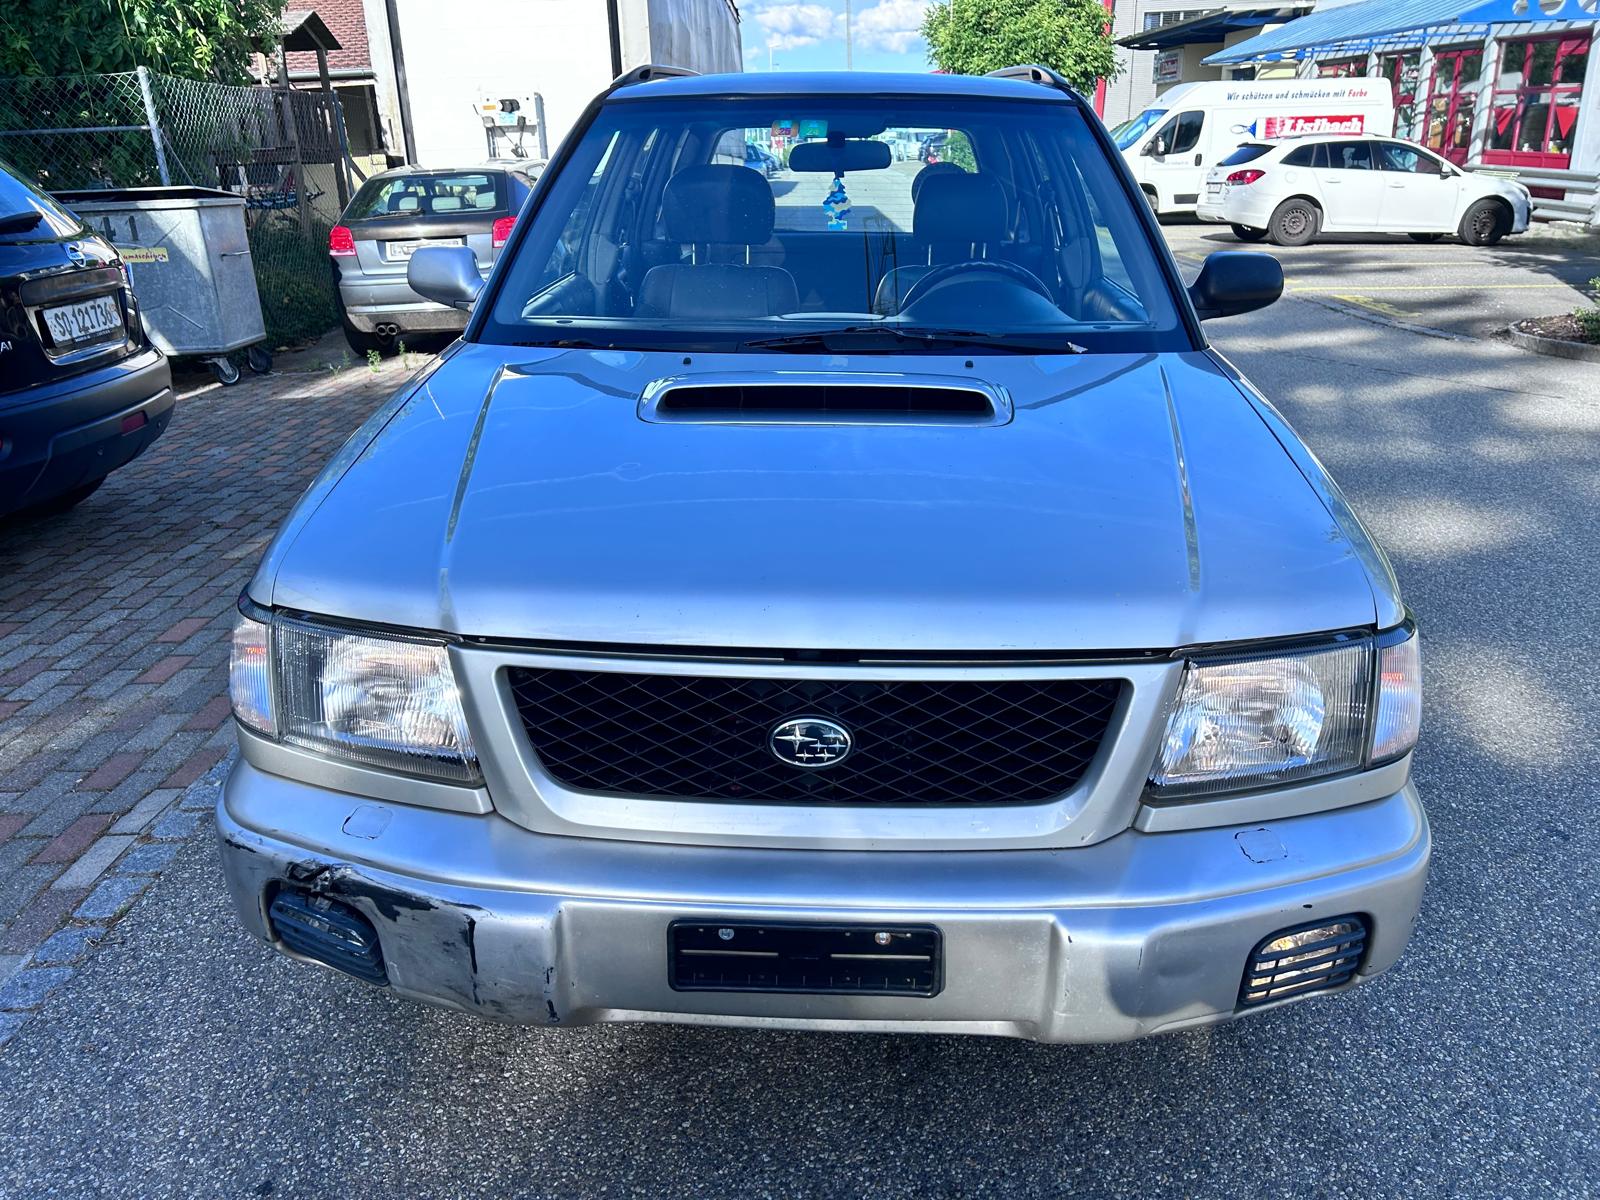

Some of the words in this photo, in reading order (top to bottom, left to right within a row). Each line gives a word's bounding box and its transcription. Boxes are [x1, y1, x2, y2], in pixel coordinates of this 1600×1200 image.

[1227, 91, 1240, 101] Wir
[1241, 91, 1273, 100] schützen
[1275, 90, 1290, 99] und
[1291, 89, 1331, 99] schmücken
[1332, 89, 1346, 98] mit
[1347, 88, 1368, 97] Farbe
[122, 252, 167, 261] umaschinen
